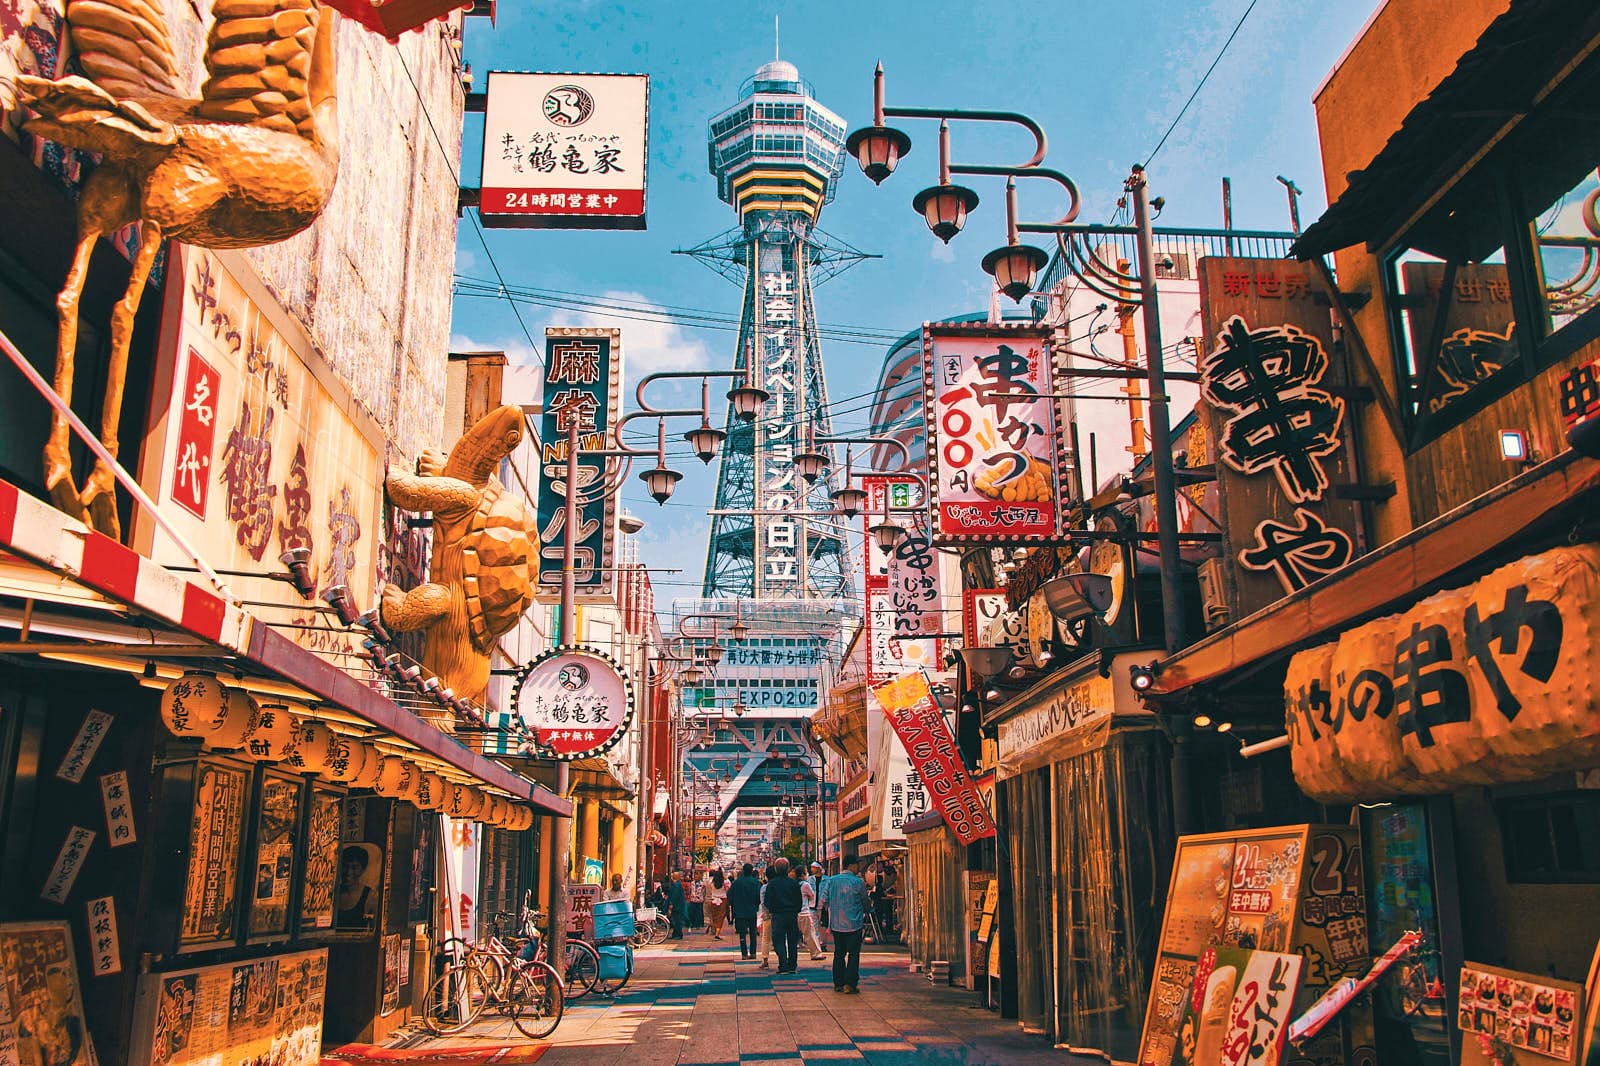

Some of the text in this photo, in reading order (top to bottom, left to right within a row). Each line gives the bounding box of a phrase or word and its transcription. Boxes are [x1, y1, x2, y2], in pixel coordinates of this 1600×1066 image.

[529, 132, 561, 144] 名代
[528, 143, 626, 174] 鶴亀家
[505, 192, 619, 208] 24時間営業中
[1223, 271, 1311, 298] 新世界
[942, 357, 963, 386] 全て
[546, 340, 601, 432] 麻雀
[763, 271, 797, 581] 社会イノベーションの日立
[969, 345, 1044, 486] 串かつ
[177, 374, 214, 506] 名代
[990, 506, 1039, 528] 大西屋
[172, 681, 193, 731] 鶴亀家
[552, 702, 611, 724] 鶴亀家
[548, 731, 596, 742] 年中無休
[1231, 892, 1271, 911] 年中無休
